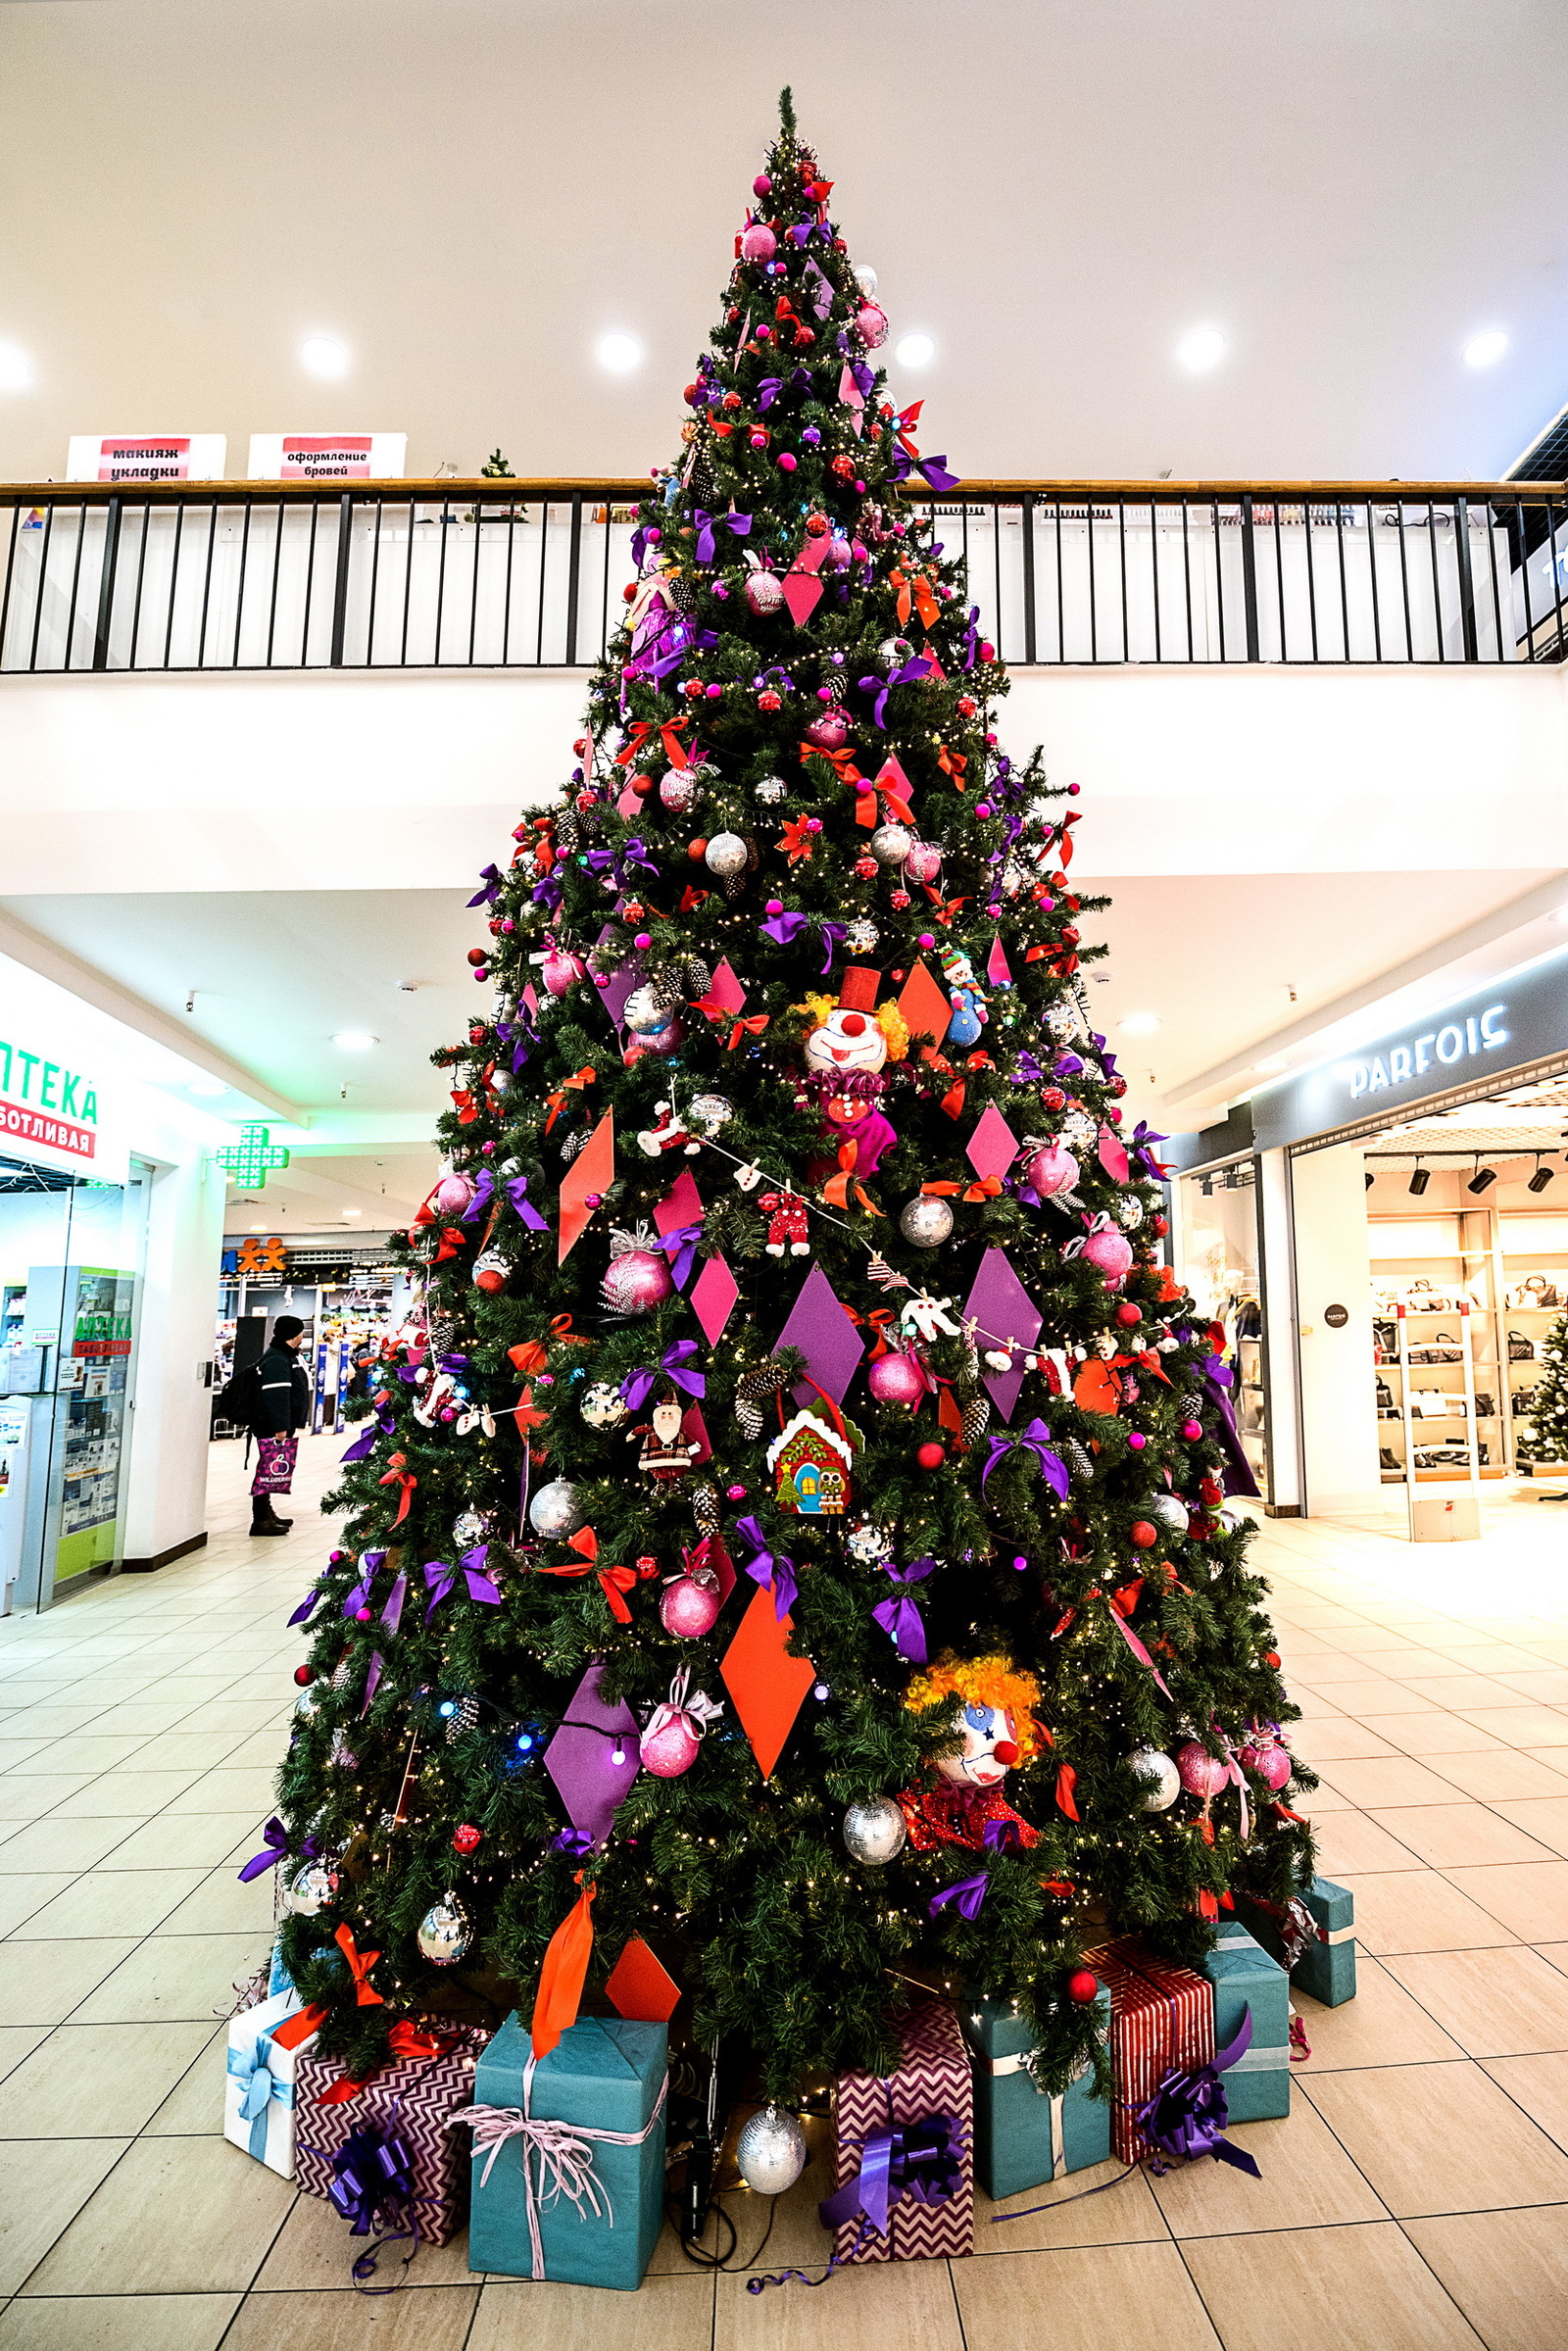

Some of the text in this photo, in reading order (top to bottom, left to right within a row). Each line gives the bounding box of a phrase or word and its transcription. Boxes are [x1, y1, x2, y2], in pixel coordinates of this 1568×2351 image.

[113, 447, 179, 460] макияж
[287, 450, 368, 464] оформление
[111, 465, 179, 481] укладки
[304, 465, 348, 478] бровей
[1350, 1004, 1508, 1100] PARFOIS
[74, 1316, 131, 1341] АПТЕКА
